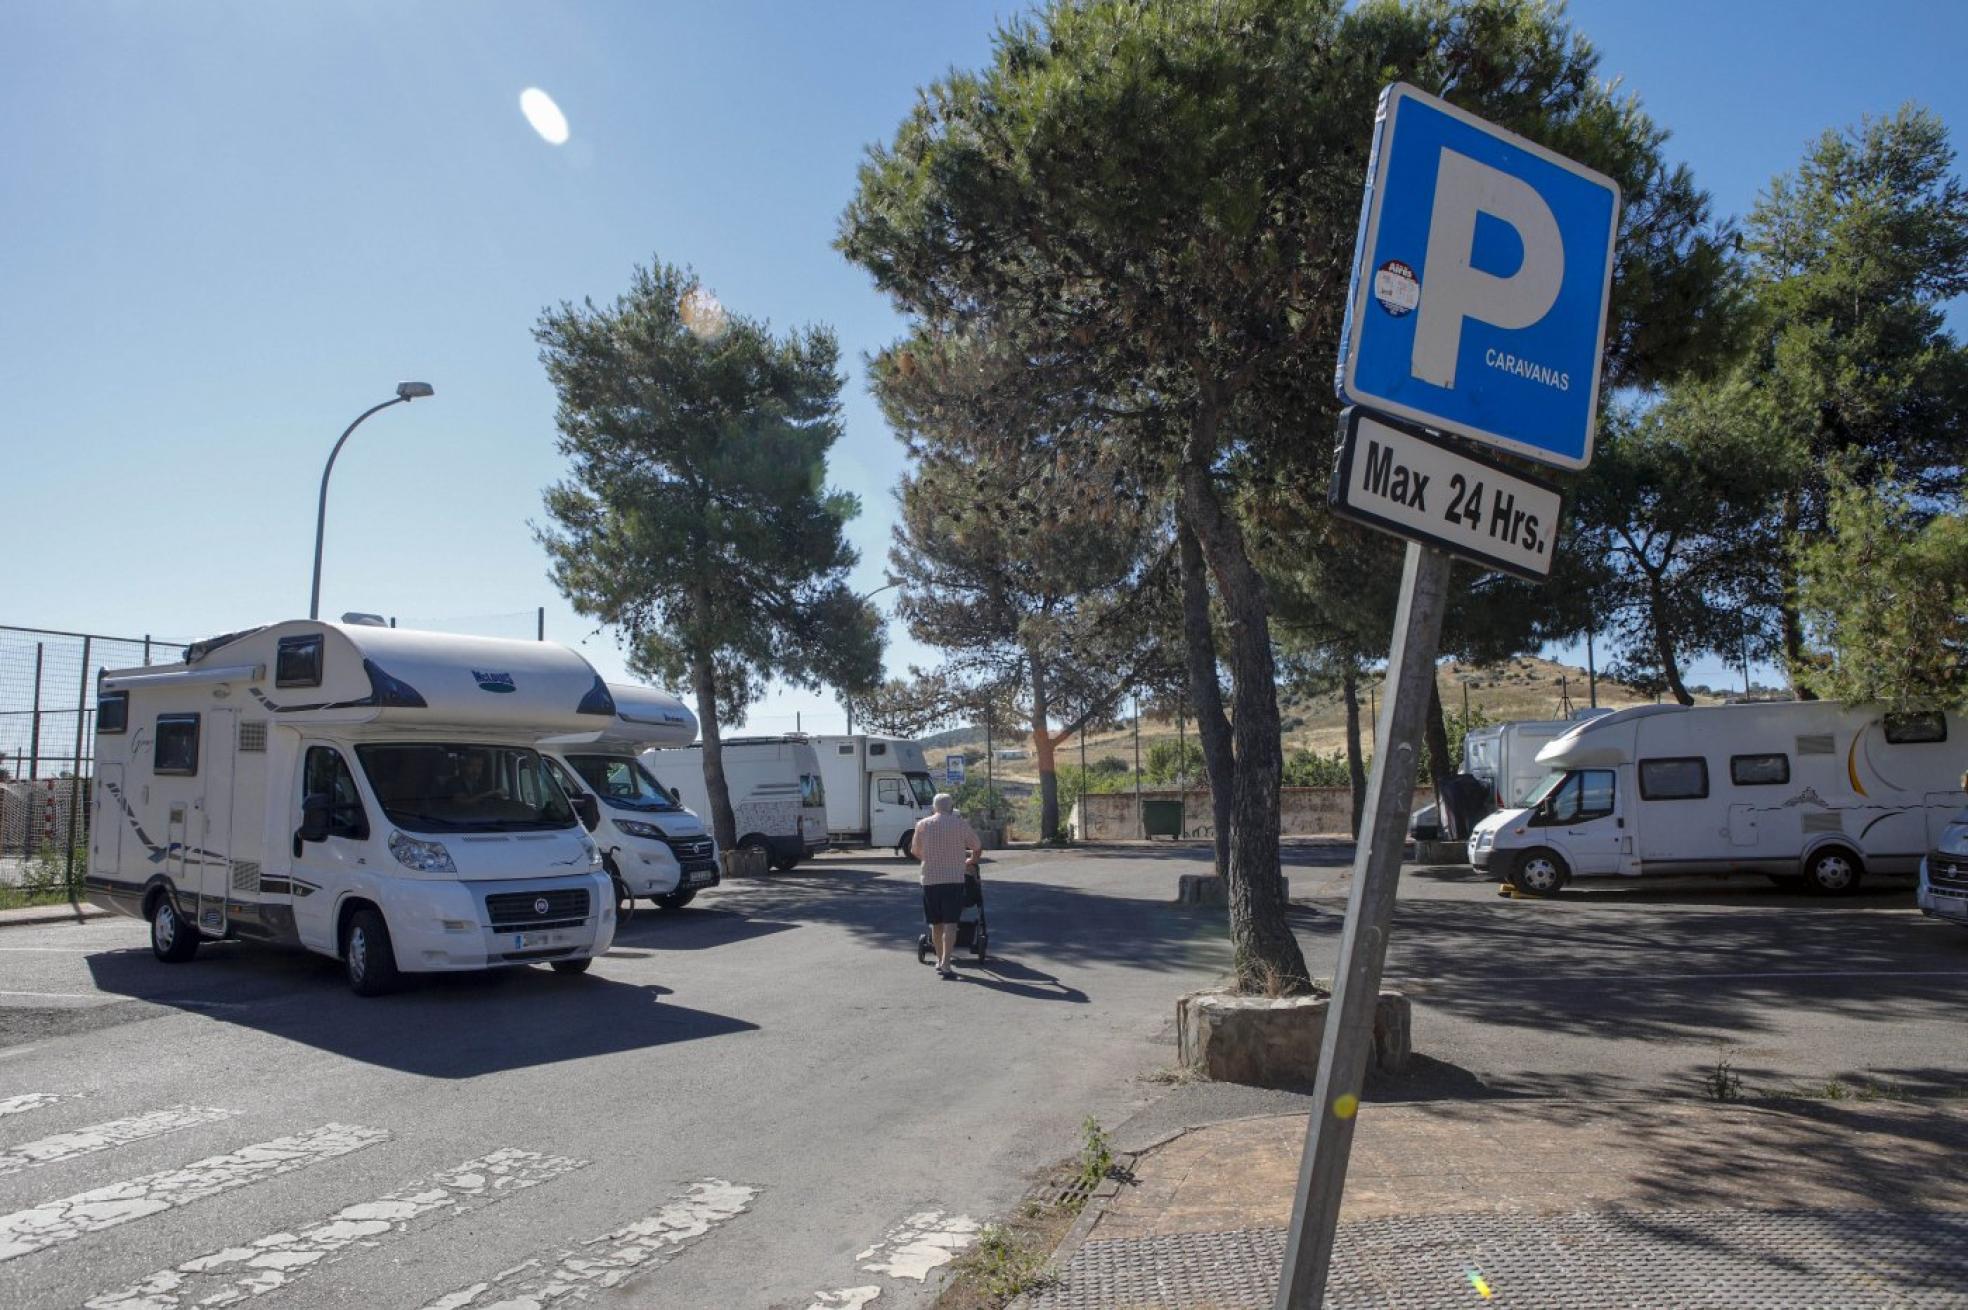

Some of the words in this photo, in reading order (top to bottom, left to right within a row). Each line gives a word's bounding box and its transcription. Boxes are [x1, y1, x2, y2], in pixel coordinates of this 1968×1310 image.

[1411, 146, 1565, 390] P
[1485, 348, 1569, 391] CARAVANAS
[1363, 440, 1430, 512] Max
[1445, 473, 1483, 531] 24
[1490, 489, 1544, 554] Hrs.
